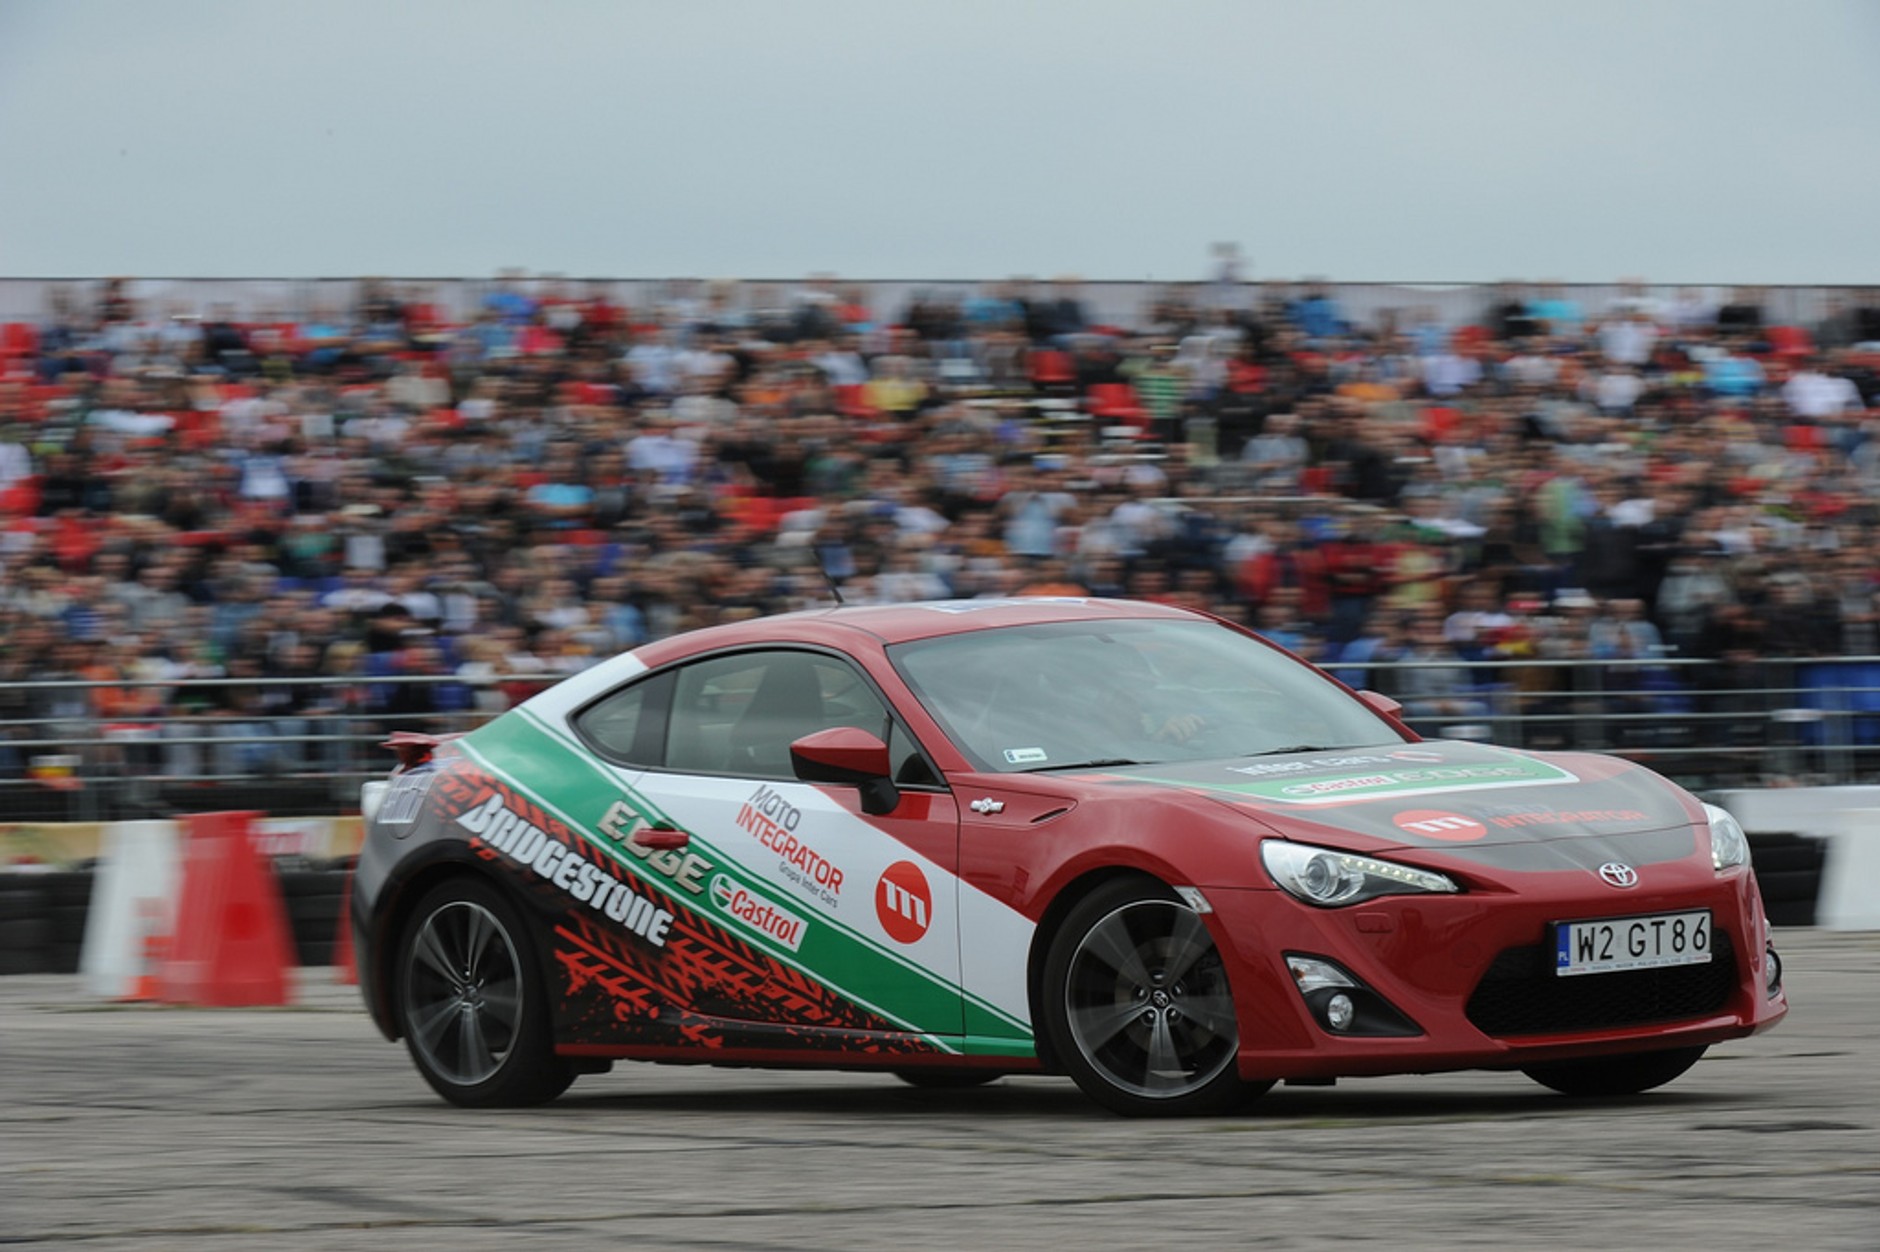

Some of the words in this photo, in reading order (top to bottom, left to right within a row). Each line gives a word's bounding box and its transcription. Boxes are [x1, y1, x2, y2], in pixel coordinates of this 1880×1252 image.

[1311, 775, 1388, 792] Castrol
[1394, 765, 1539, 781] EDGE
[750, 784, 801, 832] MOTO
[455, 793, 675, 947] BRIDGESTONE
[596, 800, 715, 896] EDGE
[736, 803, 844, 895] INTEGRATOR
[778, 861, 801, 884] Grupa
[801, 876, 820, 896] Inter
[820, 889, 839, 909] Cars
[731, 890, 801, 945] Castrol
[1577, 926, 1614, 963] W2
[1628, 916, 1707, 958] GT86
[1558, 951, 1569, 962] PL
